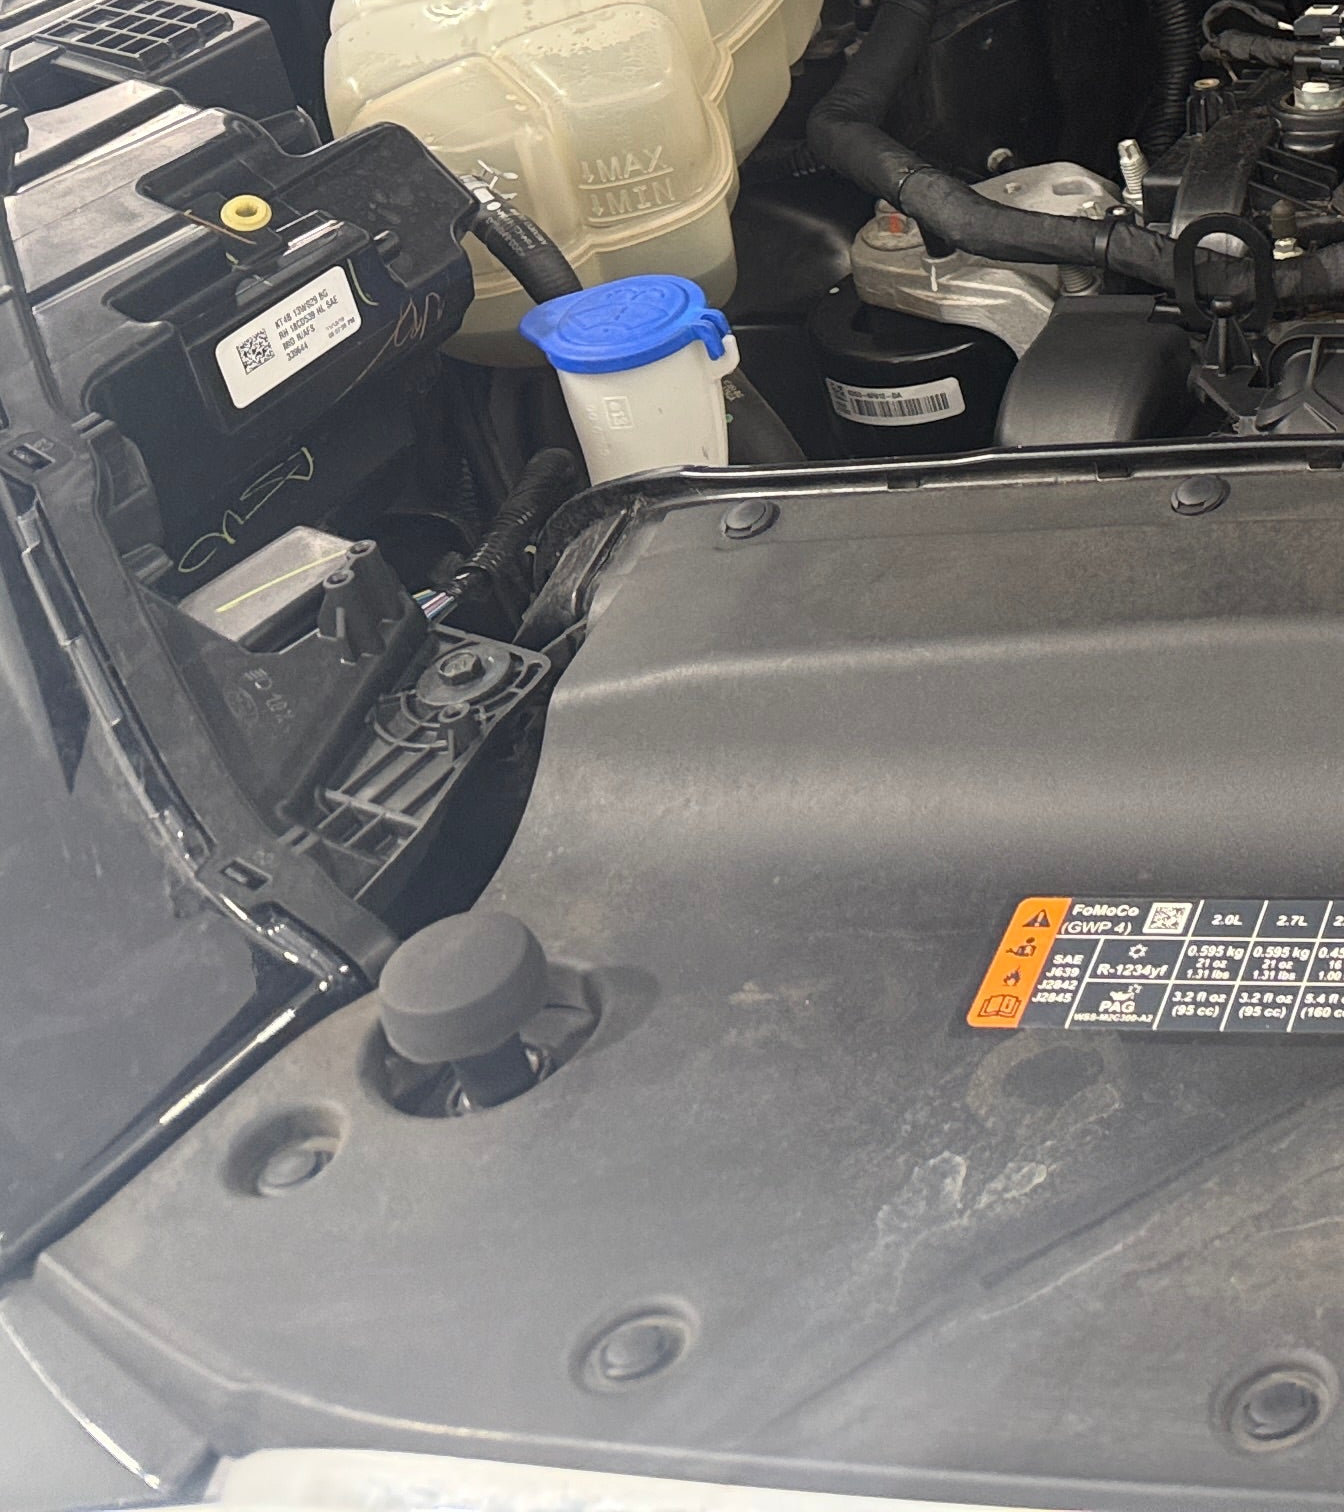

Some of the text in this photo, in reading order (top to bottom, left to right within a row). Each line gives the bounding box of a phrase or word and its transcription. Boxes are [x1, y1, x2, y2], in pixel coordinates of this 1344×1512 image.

[596, 145, 669, 183] MAX
[606, 177, 676, 215] MIN
[1072, 903, 1140, 917] FoMoCo
[1211, 914, 1243, 927] 2.0L
[1276, 915, 1308, 927] 2.7L
[1060, 920, 1132, 936] (GWP 4)
[1187, 944, 1245, 960] 0.595 kg
[1252, 945, 1311, 961] 0.595 kg
[1053, 954, 1084, 965] SAE
[1195, 958, 1228, 969] 21 oz
[1261, 959, 1293, 970] 21 oz
[1329, 960, 1343, 970] 16
[1046, 967, 1080, 978] J639
[1096, 963, 1169, 978] R-1234yf
[1186, 969, 1230, 980] 1.31 lbs
[1252, 970, 1296, 981] 1.31 lbs
[1318, 971, 1342, 981] 1.00
[1037, 979, 1079, 990] J2842
[1031, 992, 1074, 1003] J2845
[1172, 991, 1195, 1003] 3.2
[1208, 994, 1227, 1003] oz
[1238, 992, 1261, 1004] 3.2
[1275, 994, 1294, 1004] oz
[1304, 992, 1327, 1004] 5.4
[1098, 1000, 1136, 1013] PAG
[1171, 1005, 1220, 1019] (95 cc)
[1238, 1006, 1287, 1019] (95 cc)
[1300, 1006, 1332, 1020] (160
